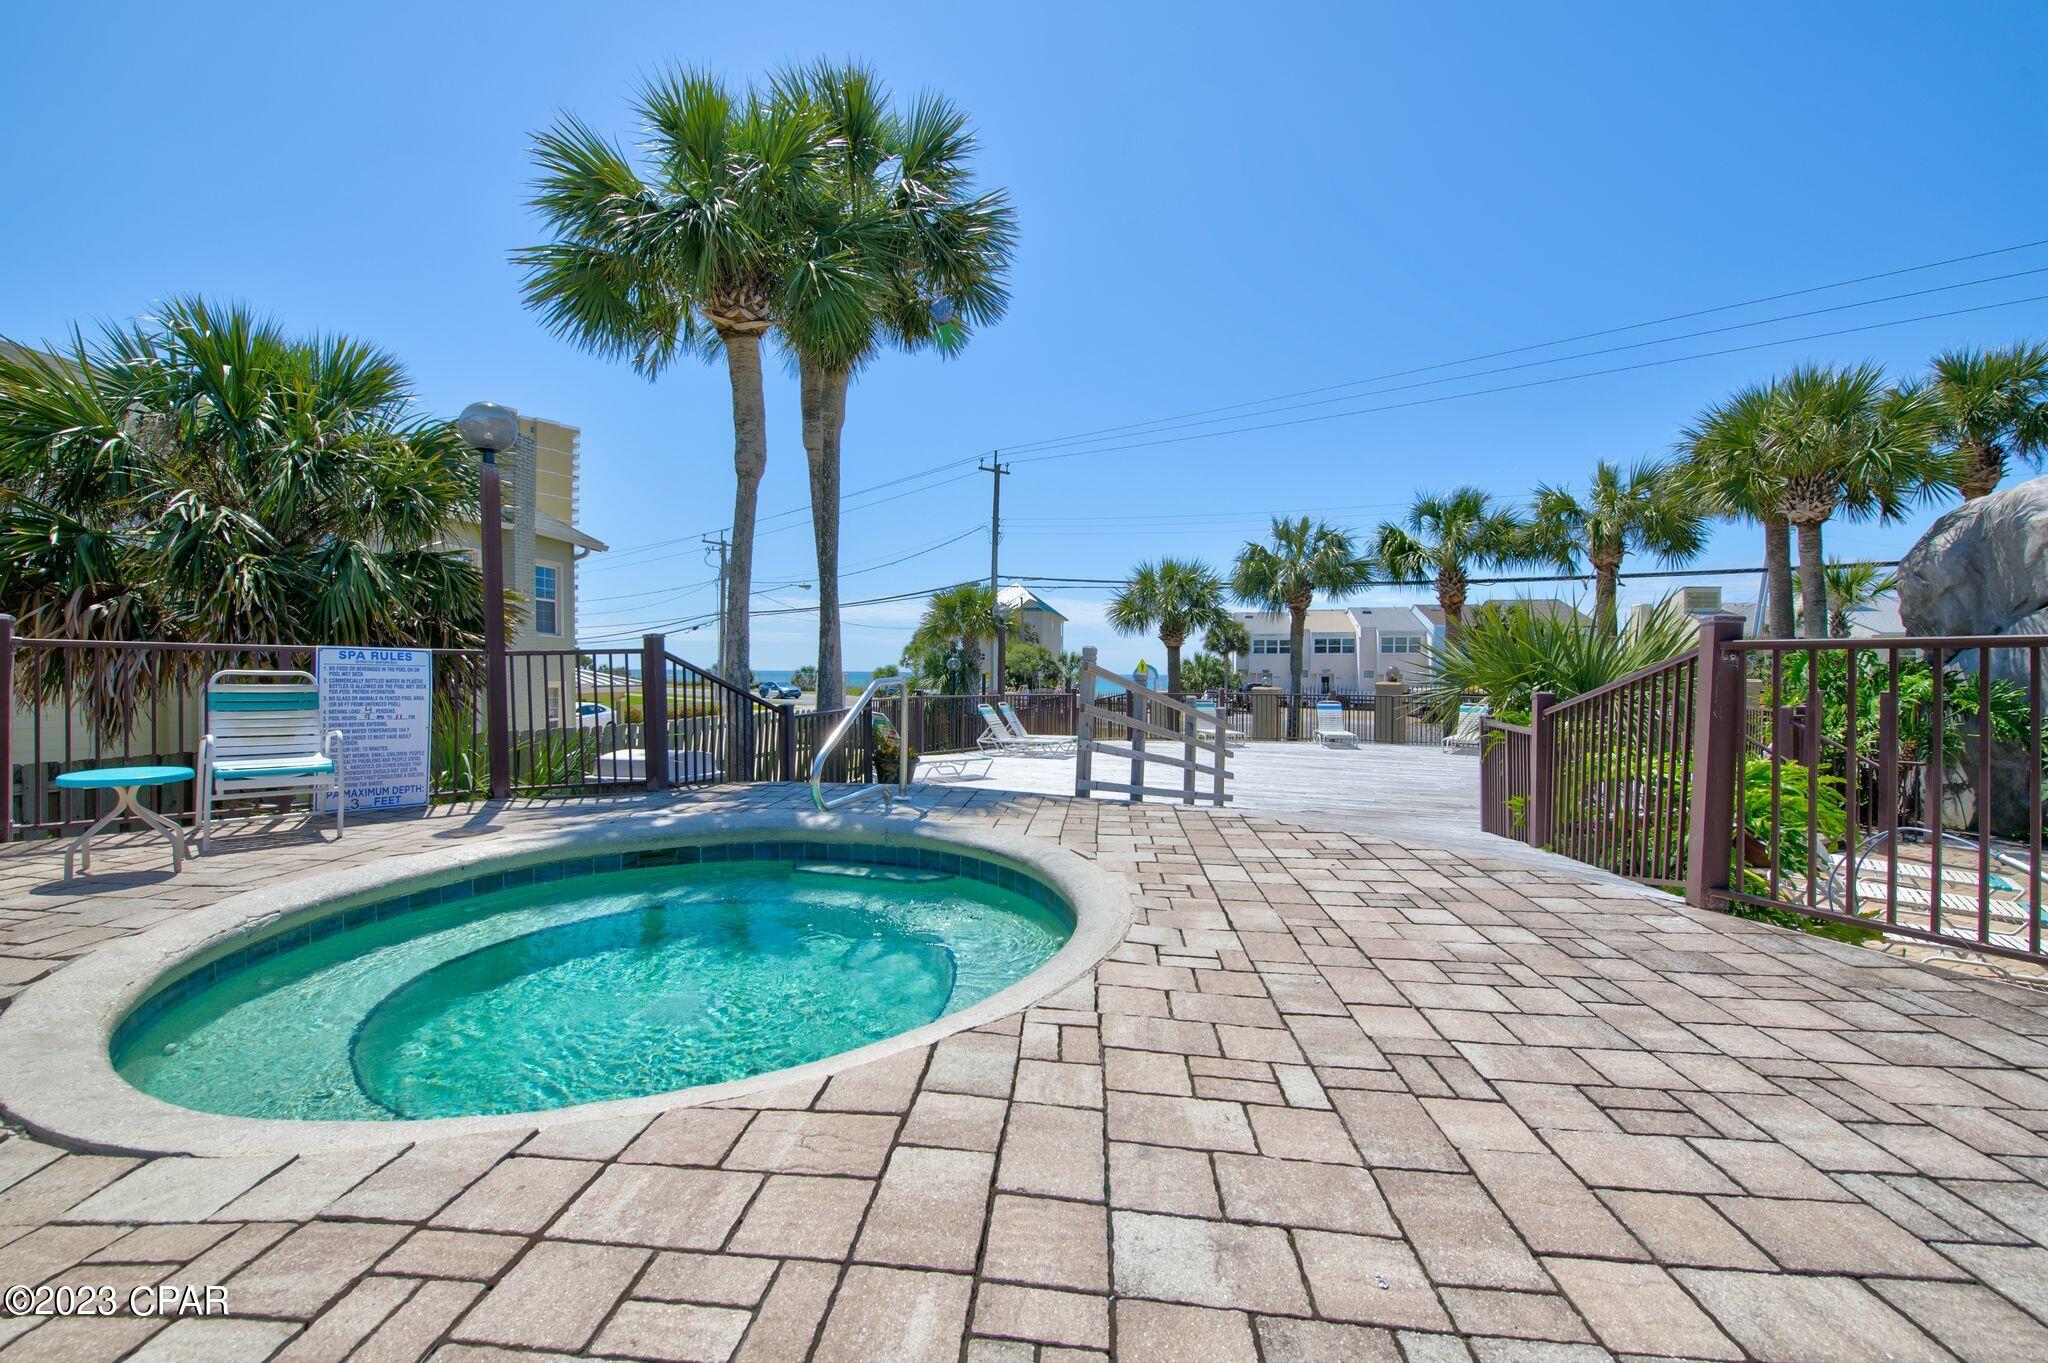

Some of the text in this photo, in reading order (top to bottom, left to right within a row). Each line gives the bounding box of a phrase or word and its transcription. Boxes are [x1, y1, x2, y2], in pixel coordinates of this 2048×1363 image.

[339, 650, 412, 661] SPA RULES
[344, 788, 389, 798] MAXIMUM
[392, 784, 424, 794] DEPTH:
[351, 795, 402, 809] 3 FEET
